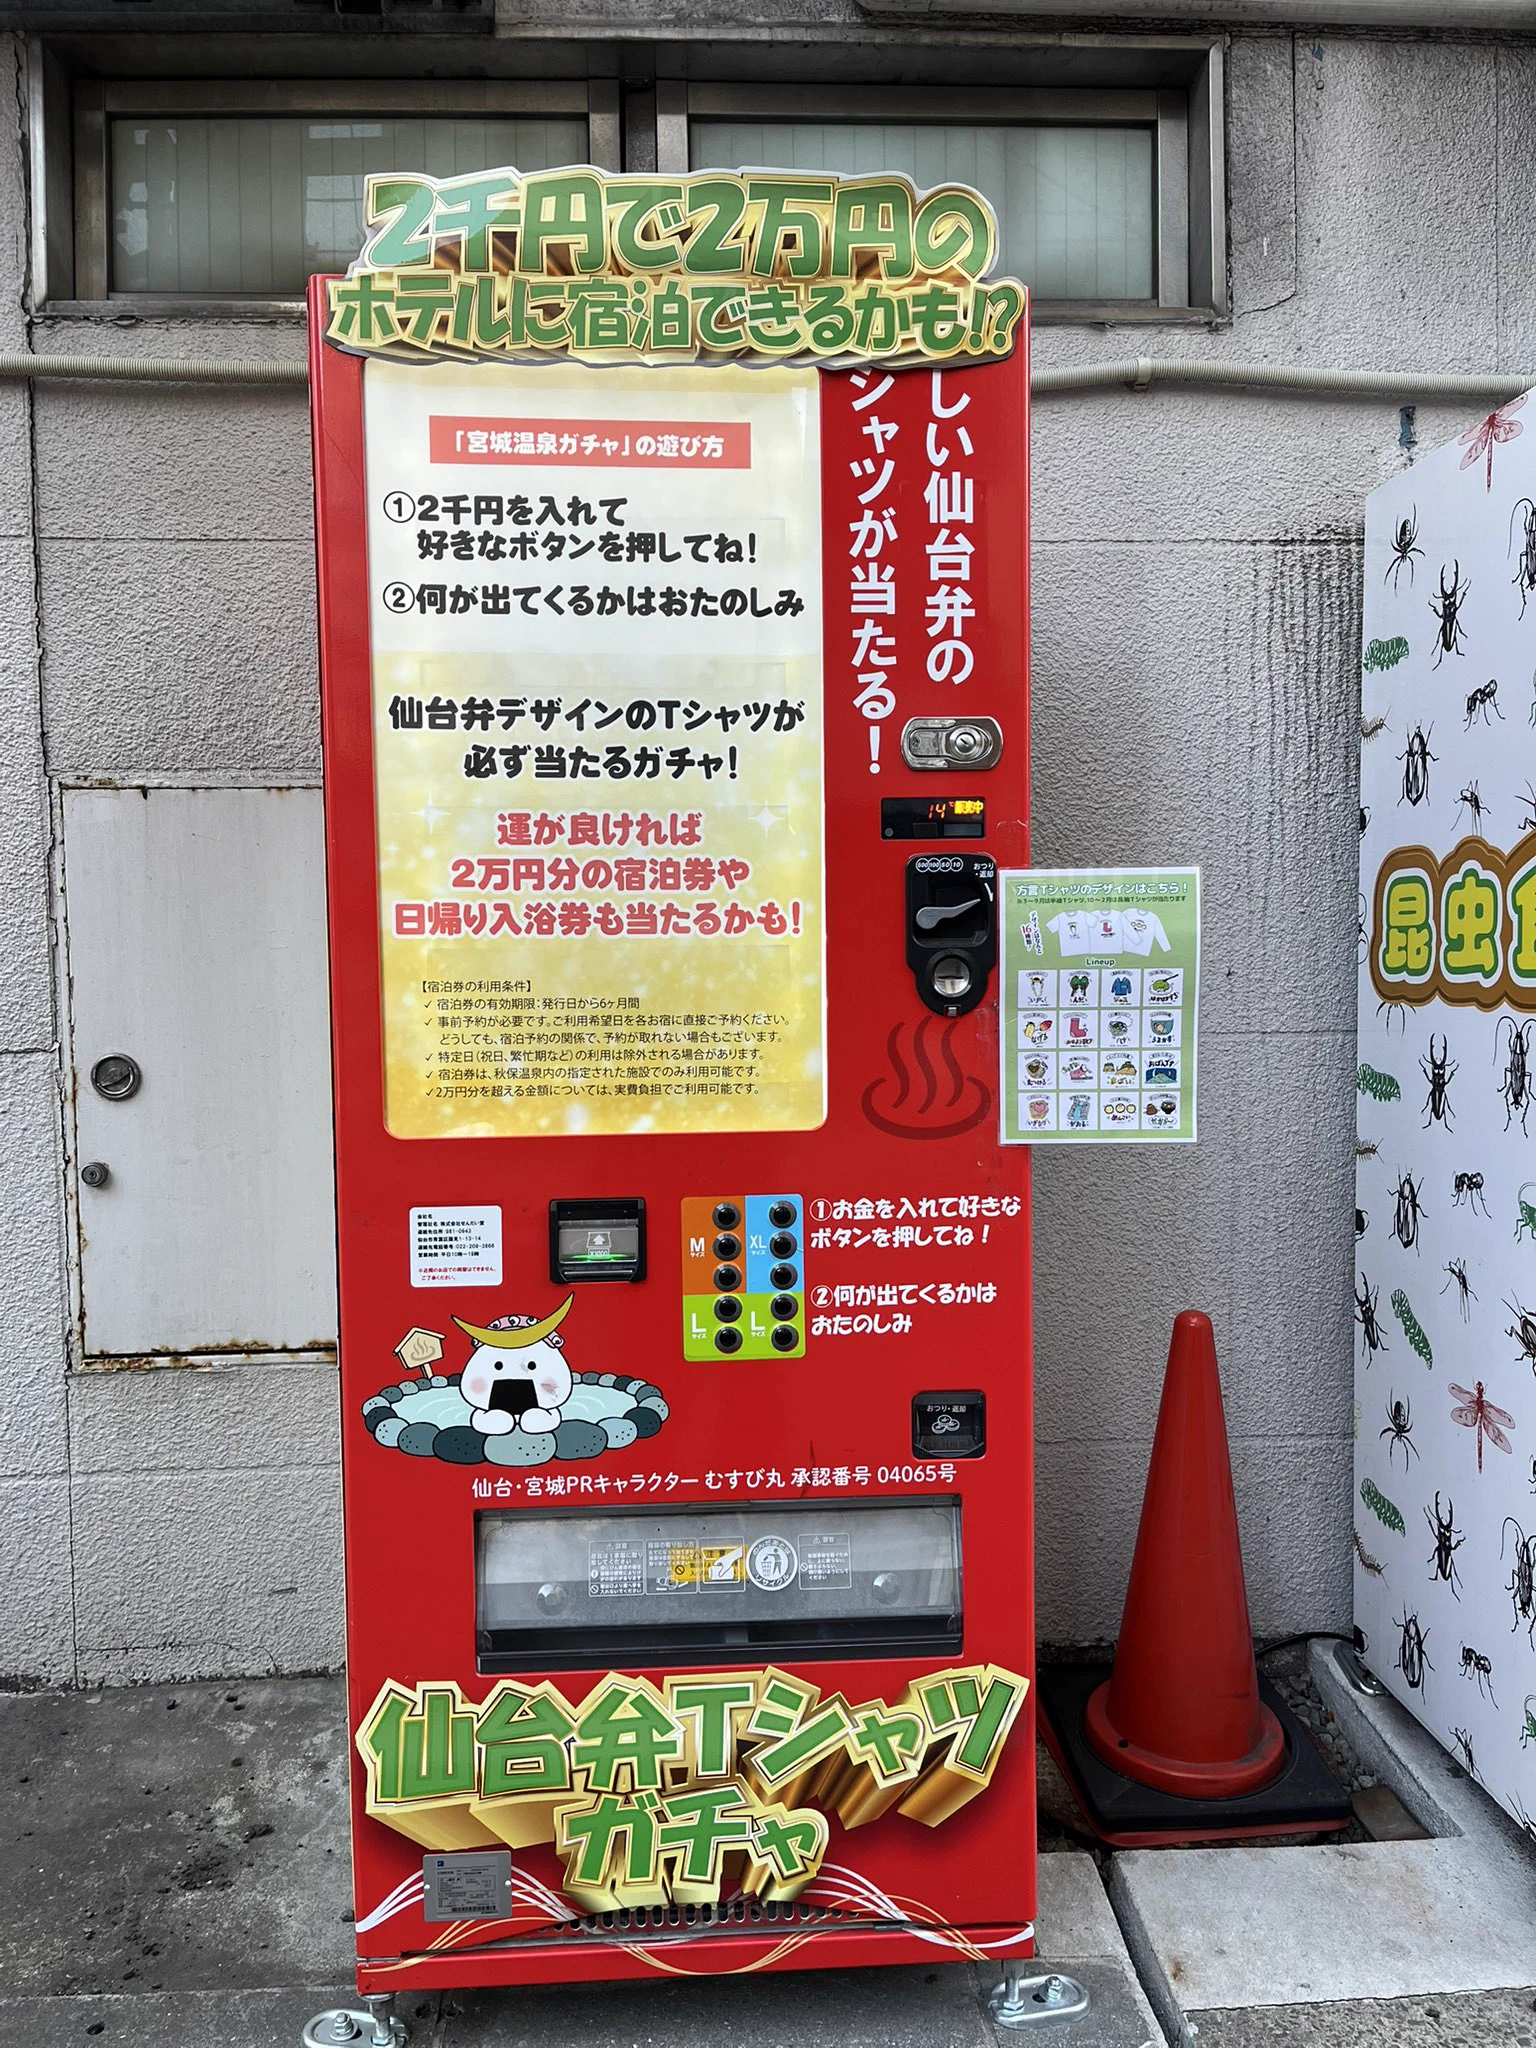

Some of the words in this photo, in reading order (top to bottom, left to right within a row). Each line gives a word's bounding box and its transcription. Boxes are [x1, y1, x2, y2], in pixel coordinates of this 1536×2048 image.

[372, 178, 996, 280] 2千円で2万円の
[454, 428, 725, 460] 「宮城温泉ガチャ」の遊び方
[923, 369, 976, 685] しい仙台弁の
[383, 584, 805, 618] ②何が出てくるかはおたのしみ
[388, 695, 805, 733] 仙台弁デザインのTシャツが
[464, 745, 738, 780] 必ず当たるガチャ!
[497, 812, 702, 846] 運が良ければ
[451, 858, 750, 892] 2万円分の宿泊券や
[973, 862, 994, 870] おつり
[1384, 875, 1536, 976] 昆虫
[1086, 958, 1115, 967] Lineup
[422, 980, 531, 993] 【宿泊券の利用条件】
[438, 1014, 790, 1028] 事前予約が必要です。ご利用希望日を各お宿に直接ご予約ください。
[440, 1031, 782, 1046] どうしても、宿泊予約の関係で、予約が取れない場合もございます。
[438, 1065, 760, 1081] 宿泊券は、秋保温泉内の指定された施設でのみ利用可能です。
[436, 1083, 759, 1098] 2万円分を超える金額については、実費負担でご利用可能です。
[810, 1195, 1021, 1222] ①お金を入れて好きな
[690, 1237, 705, 1252] M
[750, 1235, 766, 1249] XL
[810, 1282, 997, 1309] ②何が出てくるかは
[691, 1313, 706, 1333] L
[750, 1312, 766, 1332] L
[811, 1313, 913, 1336] おたのしみ
[471, 1473, 699, 1499] 仙台・宮城PRキャラクター
[705, 1468, 786, 1490] むすび丸
[790, 1466, 872, 1488] 承認番号
[877, 1465, 958, 1486] 04065号
[752, 1539, 792, 1556] のんだあとは
[755, 1573, 790, 1587] リサイクル
[368, 1677, 1022, 1806] 仙台弁Tシャツ
[562, 1783, 828, 1889] ガチャ
